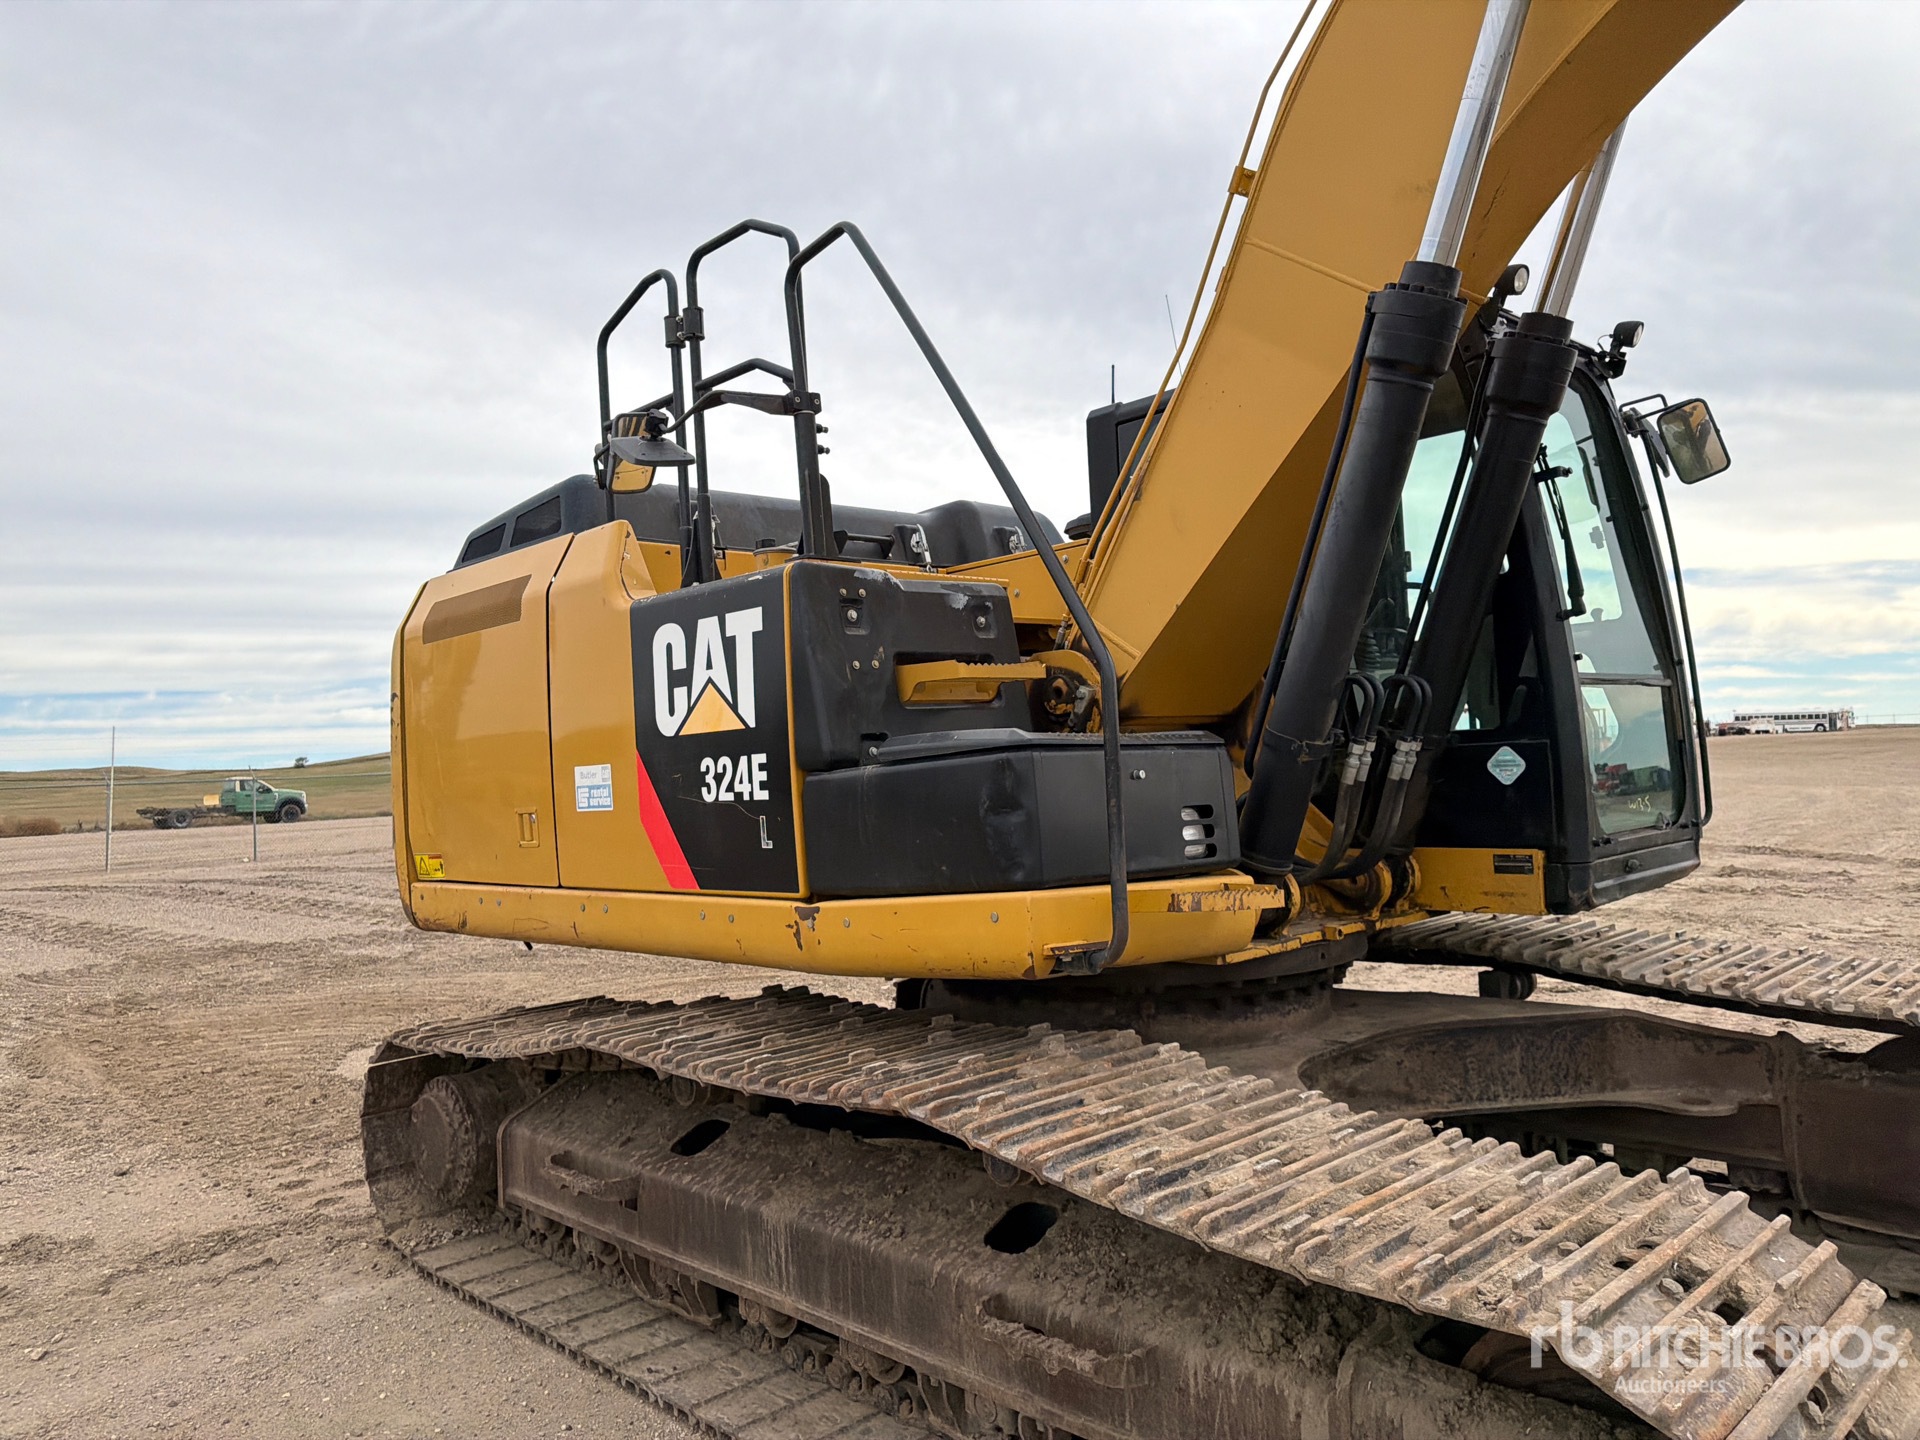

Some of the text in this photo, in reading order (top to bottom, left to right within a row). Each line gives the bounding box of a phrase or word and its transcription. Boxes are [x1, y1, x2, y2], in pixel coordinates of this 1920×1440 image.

[652, 606, 763, 738] CAT
[700, 753, 770, 803] 324E
[759, 815, 773, 849] L
